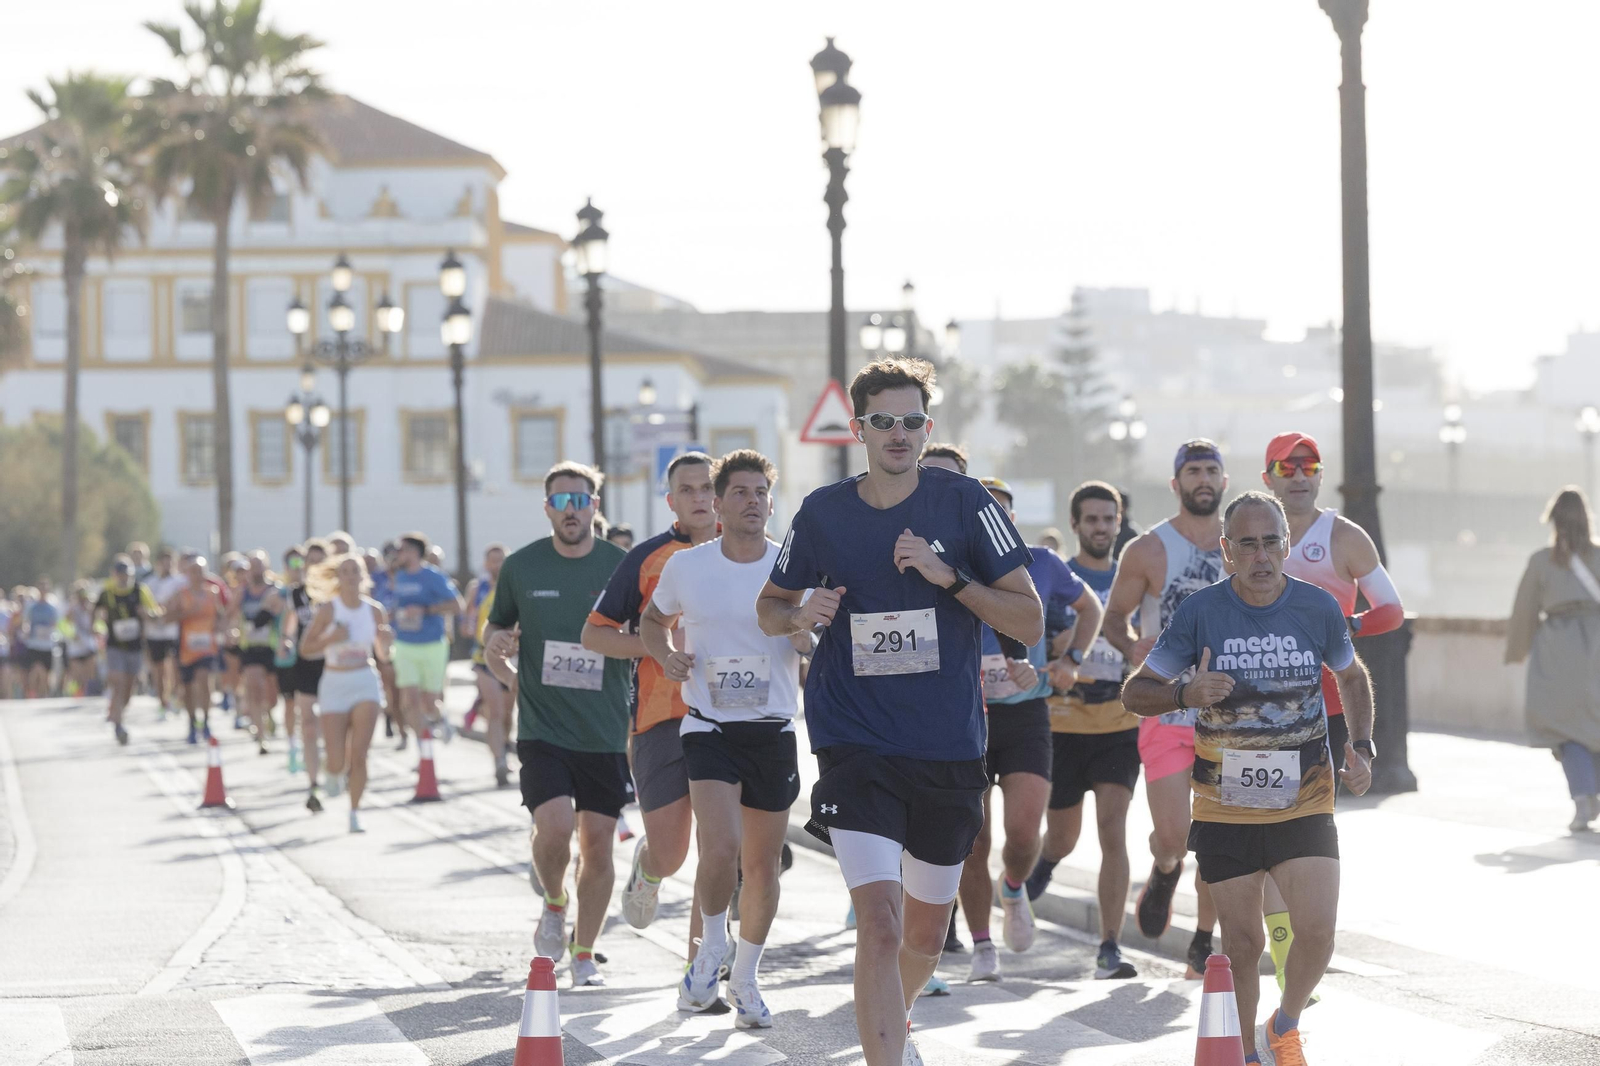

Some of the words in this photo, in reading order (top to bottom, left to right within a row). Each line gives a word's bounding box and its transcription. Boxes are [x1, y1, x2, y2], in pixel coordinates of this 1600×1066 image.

[872, 629, 917, 653] 291
[1223, 633, 1298, 653] media
[552, 655, 596, 674] 2127
[1216, 650, 1316, 670] maraton
[717, 671, 755, 689] 732
[984, 667, 1009, 684] 52
[1244, 669, 1275, 679] CIUDAD
[1280, 668, 1290, 678] DE
[1240, 767, 1284, 789] 592
